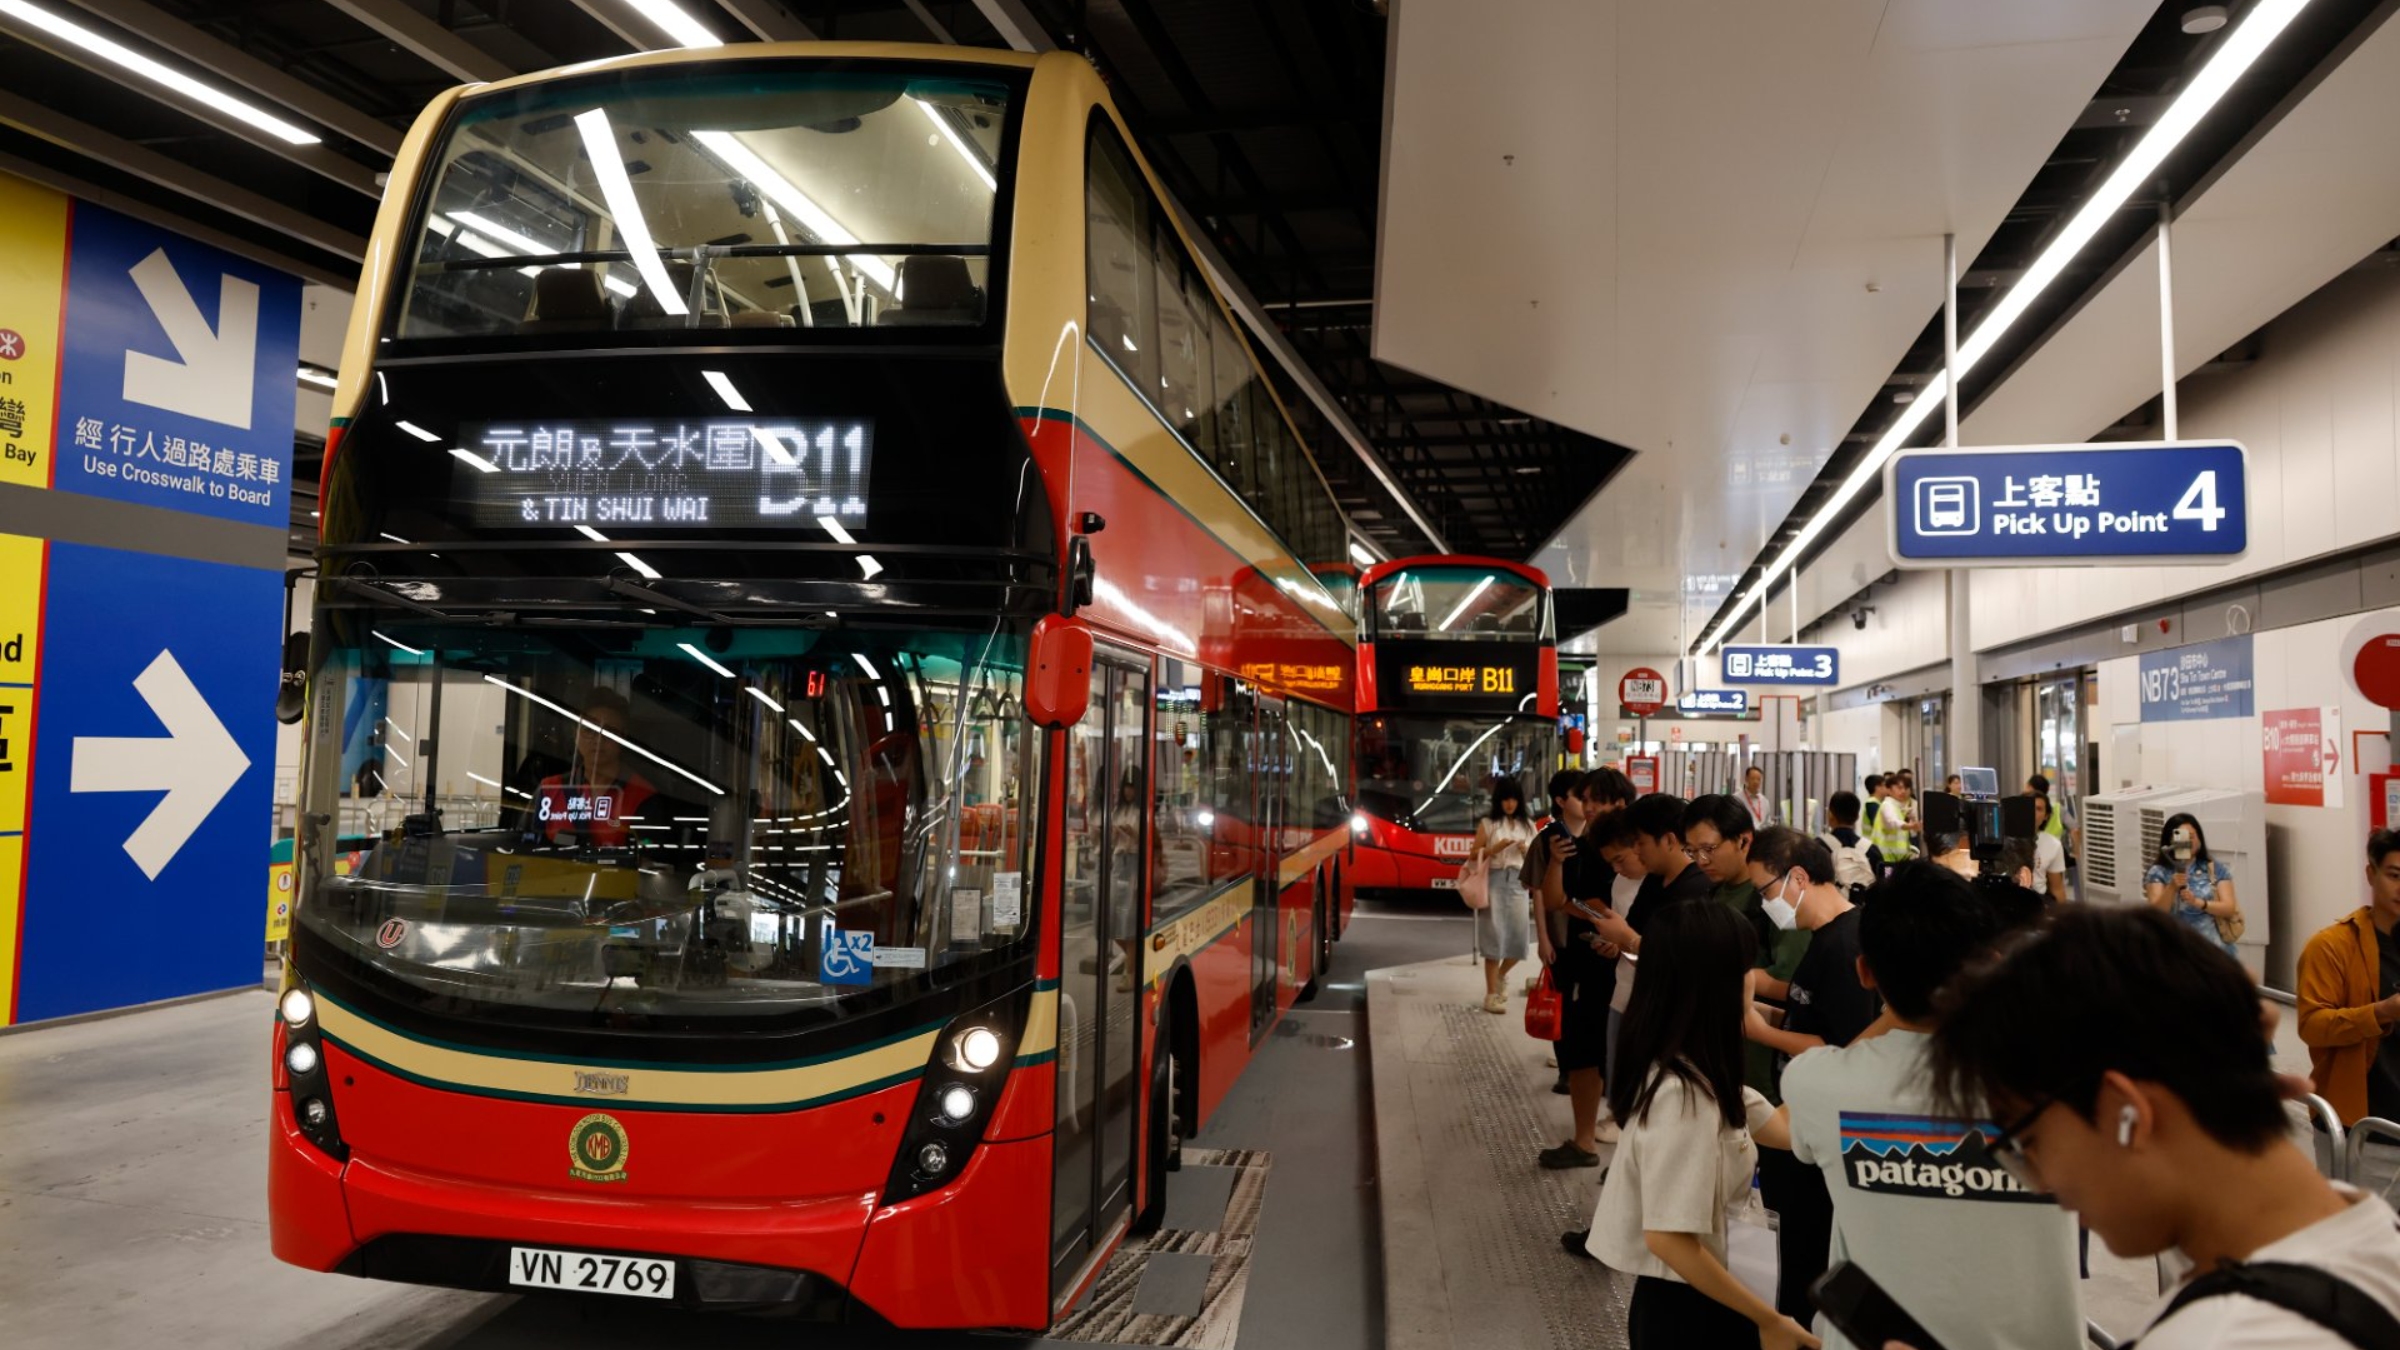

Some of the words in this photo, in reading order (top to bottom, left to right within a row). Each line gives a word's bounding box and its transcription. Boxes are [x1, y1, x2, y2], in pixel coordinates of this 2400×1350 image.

[5, 442, 36, 467] Bay
[482, 424, 755, 470] 元朗及天水圍
[84, 454, 117, 478] Use
[122, 463, 205, 494] Crosswalk
[209, 481, 225, 497] to
[228, 483, 271, 507] Board
[759, 425, 866, 514] B11
[1993, 473, 2100, 507] 上客點
[2172, 470, 2226, 532] 4
[522, 498, 539, 521] &
[545, 498, 588, 521] TIN
[597, 498, 653, 521] SHUI
[664, 498, 708, 521] WAI
[1993, 511, 2047, 534] Pick
[2053, 512, 2091, 539] Up
[2098, 511, 2169, 533] Point
[1483, 667, 1514, 692] B11
[1814, 654, 1833, 679] 3
[2141, 666, 2179, 703] NB73
[1731, 693, 1744, 709] 2
[851, 933, 873, 950] x2
[587, 1133, 611, 1159] KMB
[1855, 1158, 2034, 1197] patagon
[521, 1251, 562, 1285] VN
[578, 1257, 668, 1294] 2769
